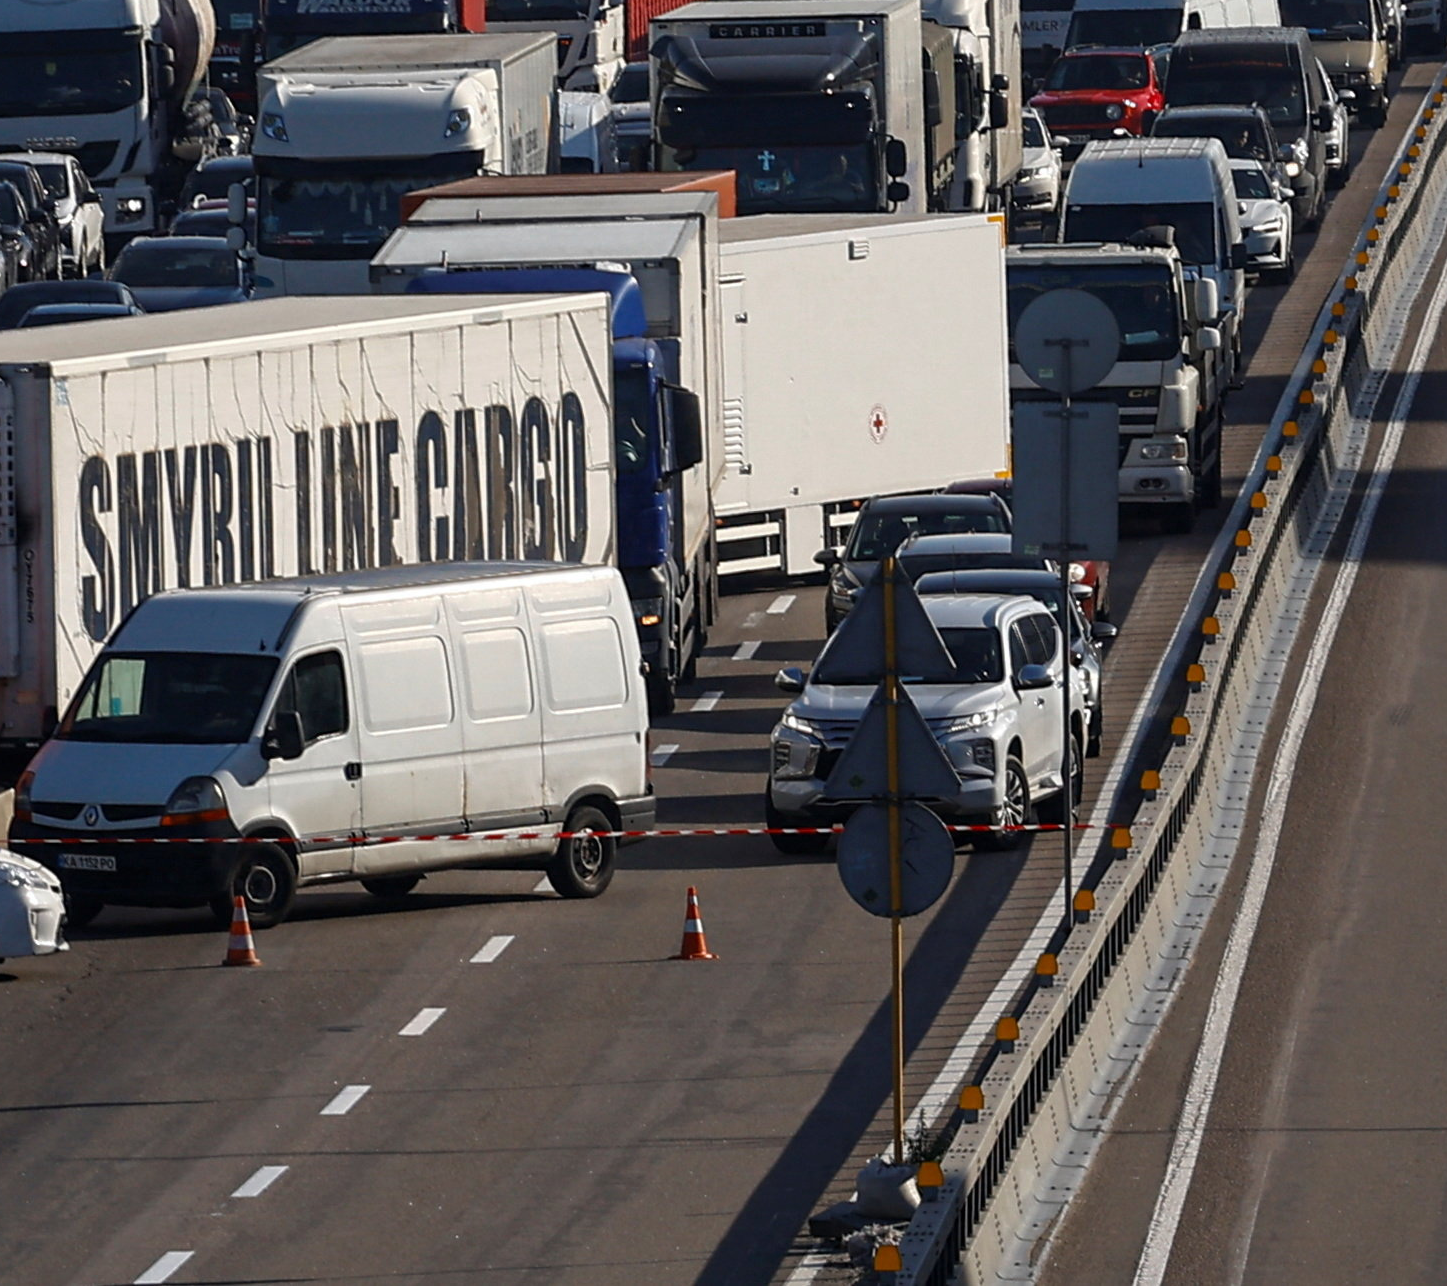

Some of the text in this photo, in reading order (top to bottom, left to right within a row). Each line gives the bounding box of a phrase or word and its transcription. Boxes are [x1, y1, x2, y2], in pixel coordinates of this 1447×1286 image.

[718, 25, 817, 37] CARRIER
[296, 419, 402, 577] LINE
[417, 392, 588, 564] CARGO
